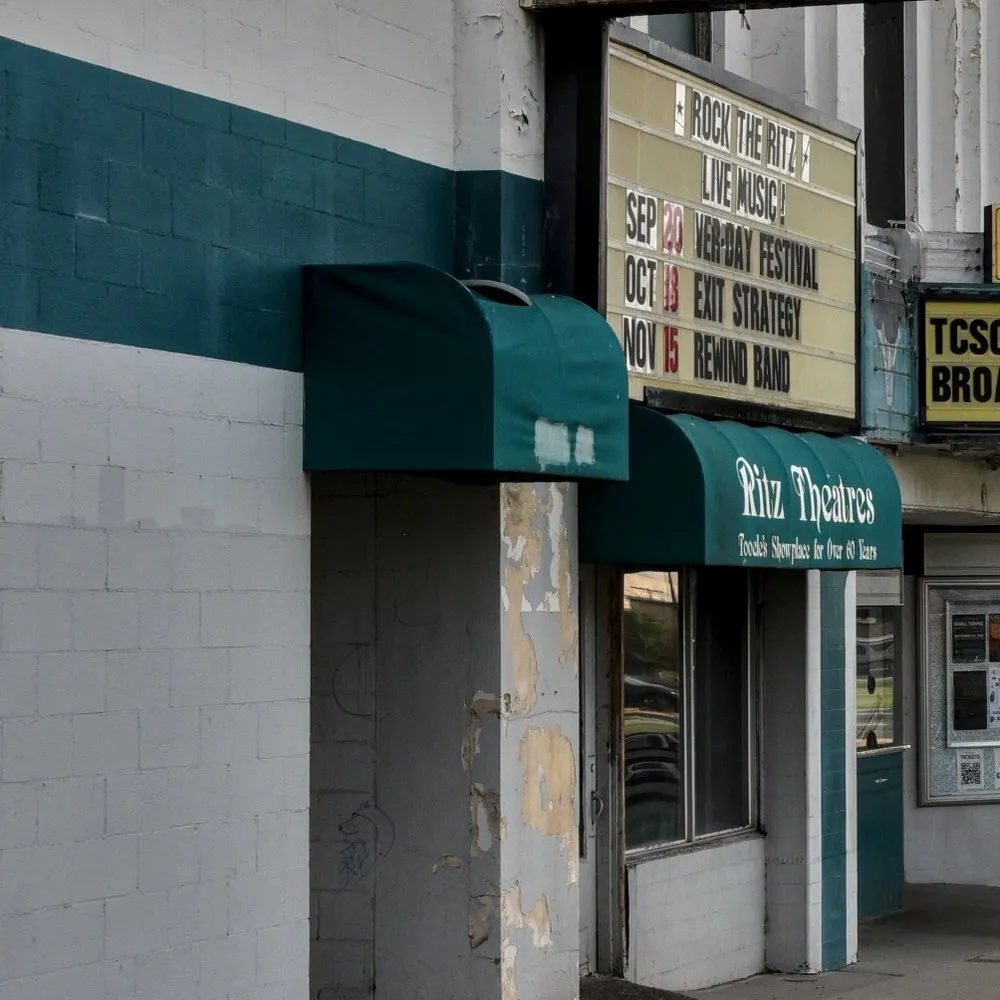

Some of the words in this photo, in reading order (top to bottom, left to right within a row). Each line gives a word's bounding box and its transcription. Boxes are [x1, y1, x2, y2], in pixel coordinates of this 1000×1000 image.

[692, 90, 731, 149] ROCK
[737, 109, 762, 161] THE
[768, 122, 796, 173] RITZ
[702, 154, 731, 207] LIVE
[627, 192, 657, 245] SEP
[663, 205, 683, 253] 20
[759, 233, 818, 290] FESTIVAL
[626, 255, 656, 307] OCT
[695, 272, 725, 323] EXIT
[733, 283, 801, 340] STRATEGY
[623, 317, 656, 370] NOV
[663, 326, 679, 373] 15
[694, 332, 748, 385] REWIND
[753, 345, 790, 393] BAND
[736, 457, 785, 519] Ritz
[791, 465, 875, 533] Theatres
[738, 533, 767, 557] Tooele's
[771, 536, 810, 565] Showplace
[813, 538, 824, 560] for
[827, 538, 843, 560] Over
[858, 539, 877, 560] Years
